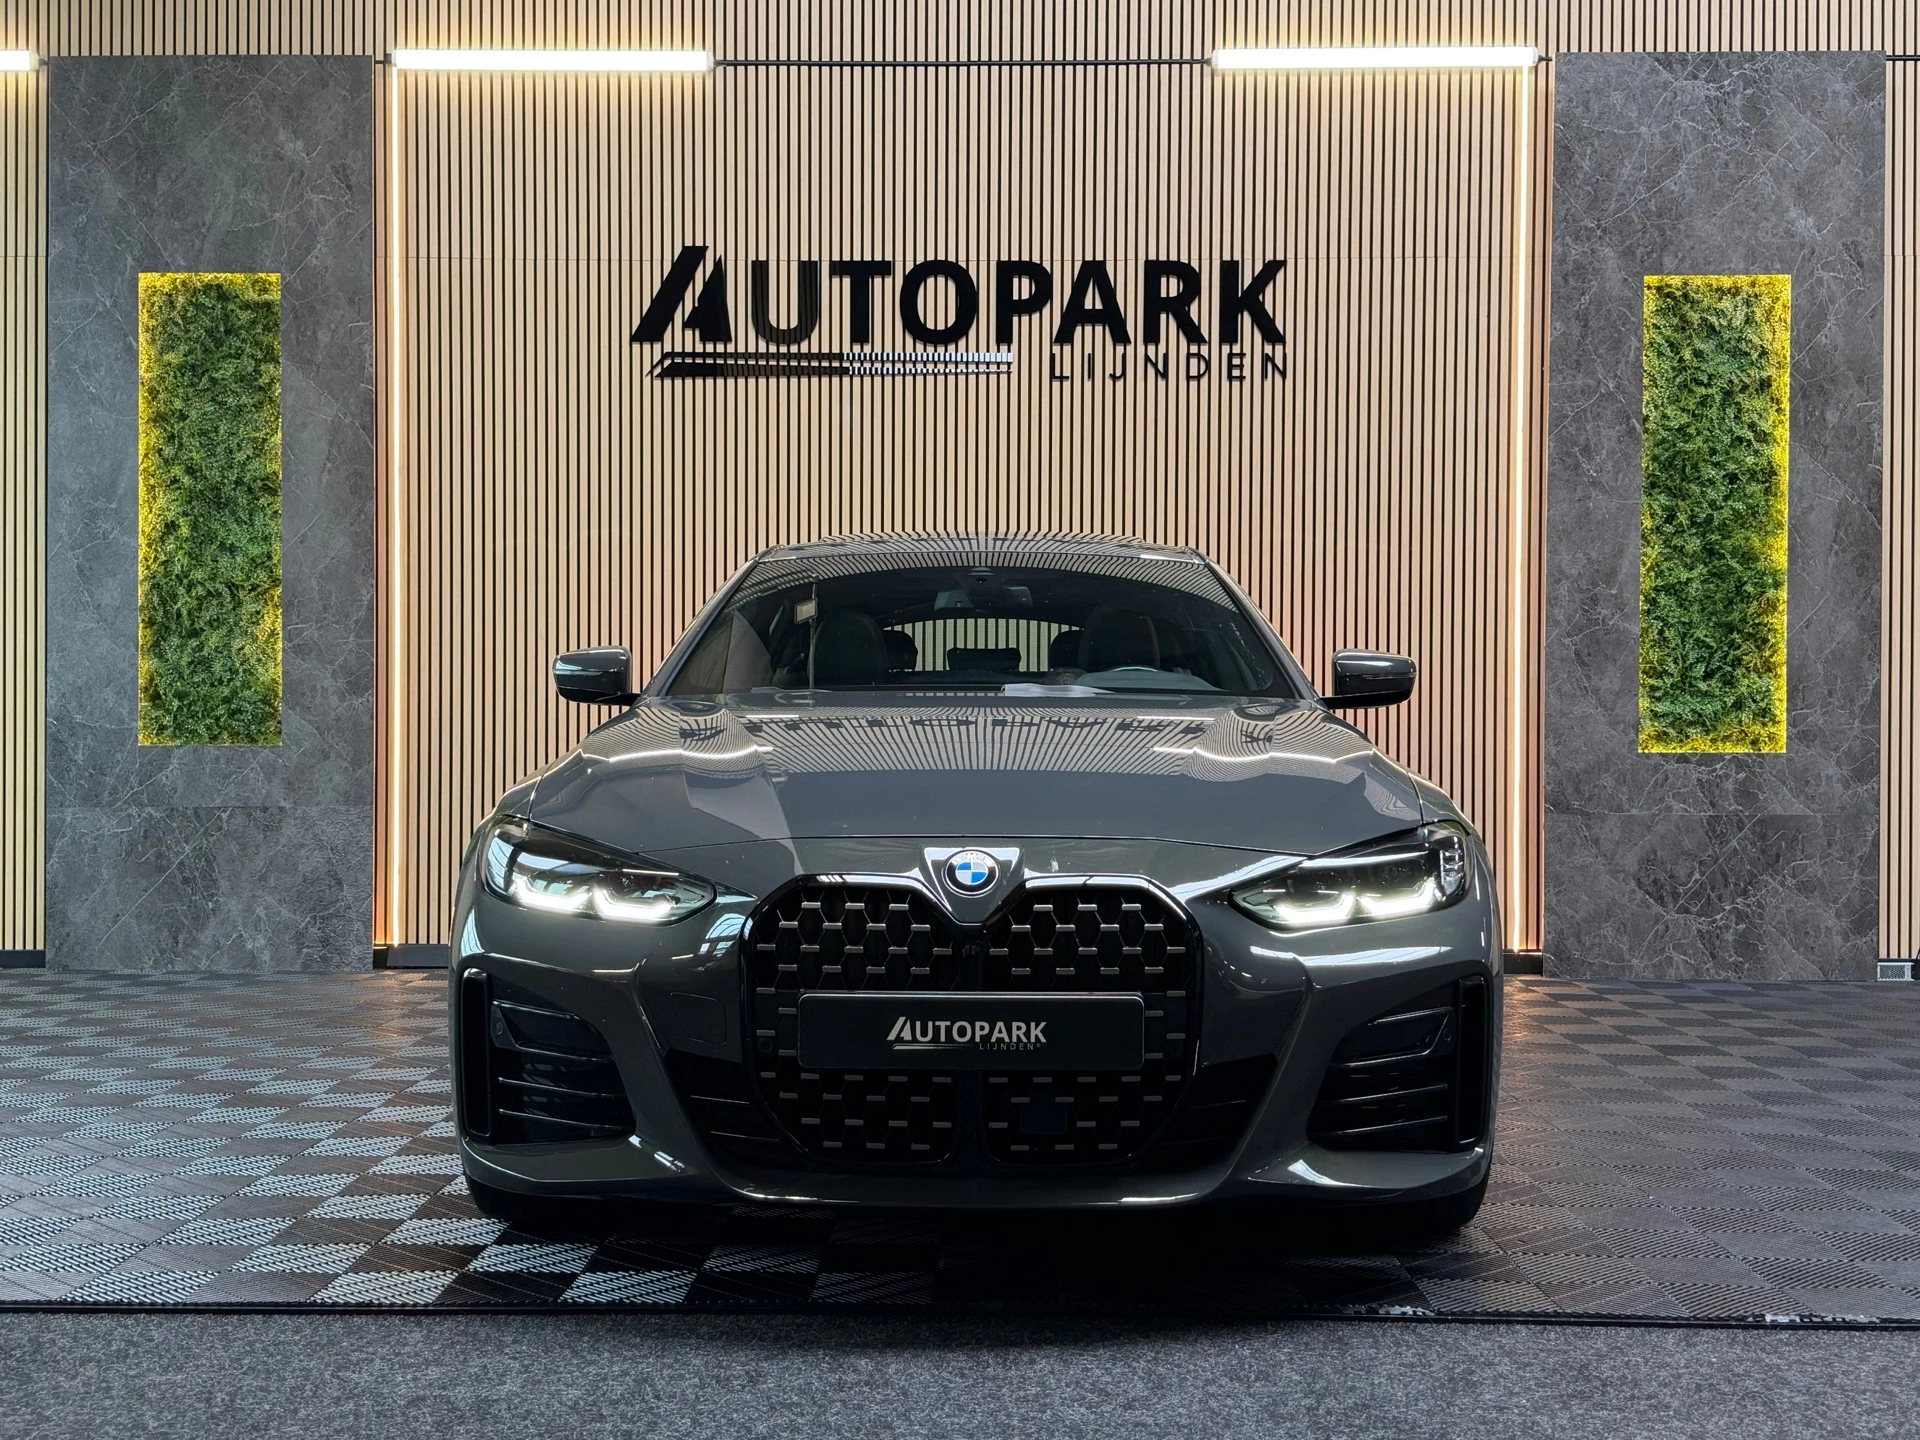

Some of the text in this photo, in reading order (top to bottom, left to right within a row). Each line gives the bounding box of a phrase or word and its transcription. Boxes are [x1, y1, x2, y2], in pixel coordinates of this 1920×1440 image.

[630, 246, 1287, 345] AUTOPARK
[1051, 352, 1287, 380] LIJNDEN
[886, 1016, 1047, 1042] AUTOPARK
